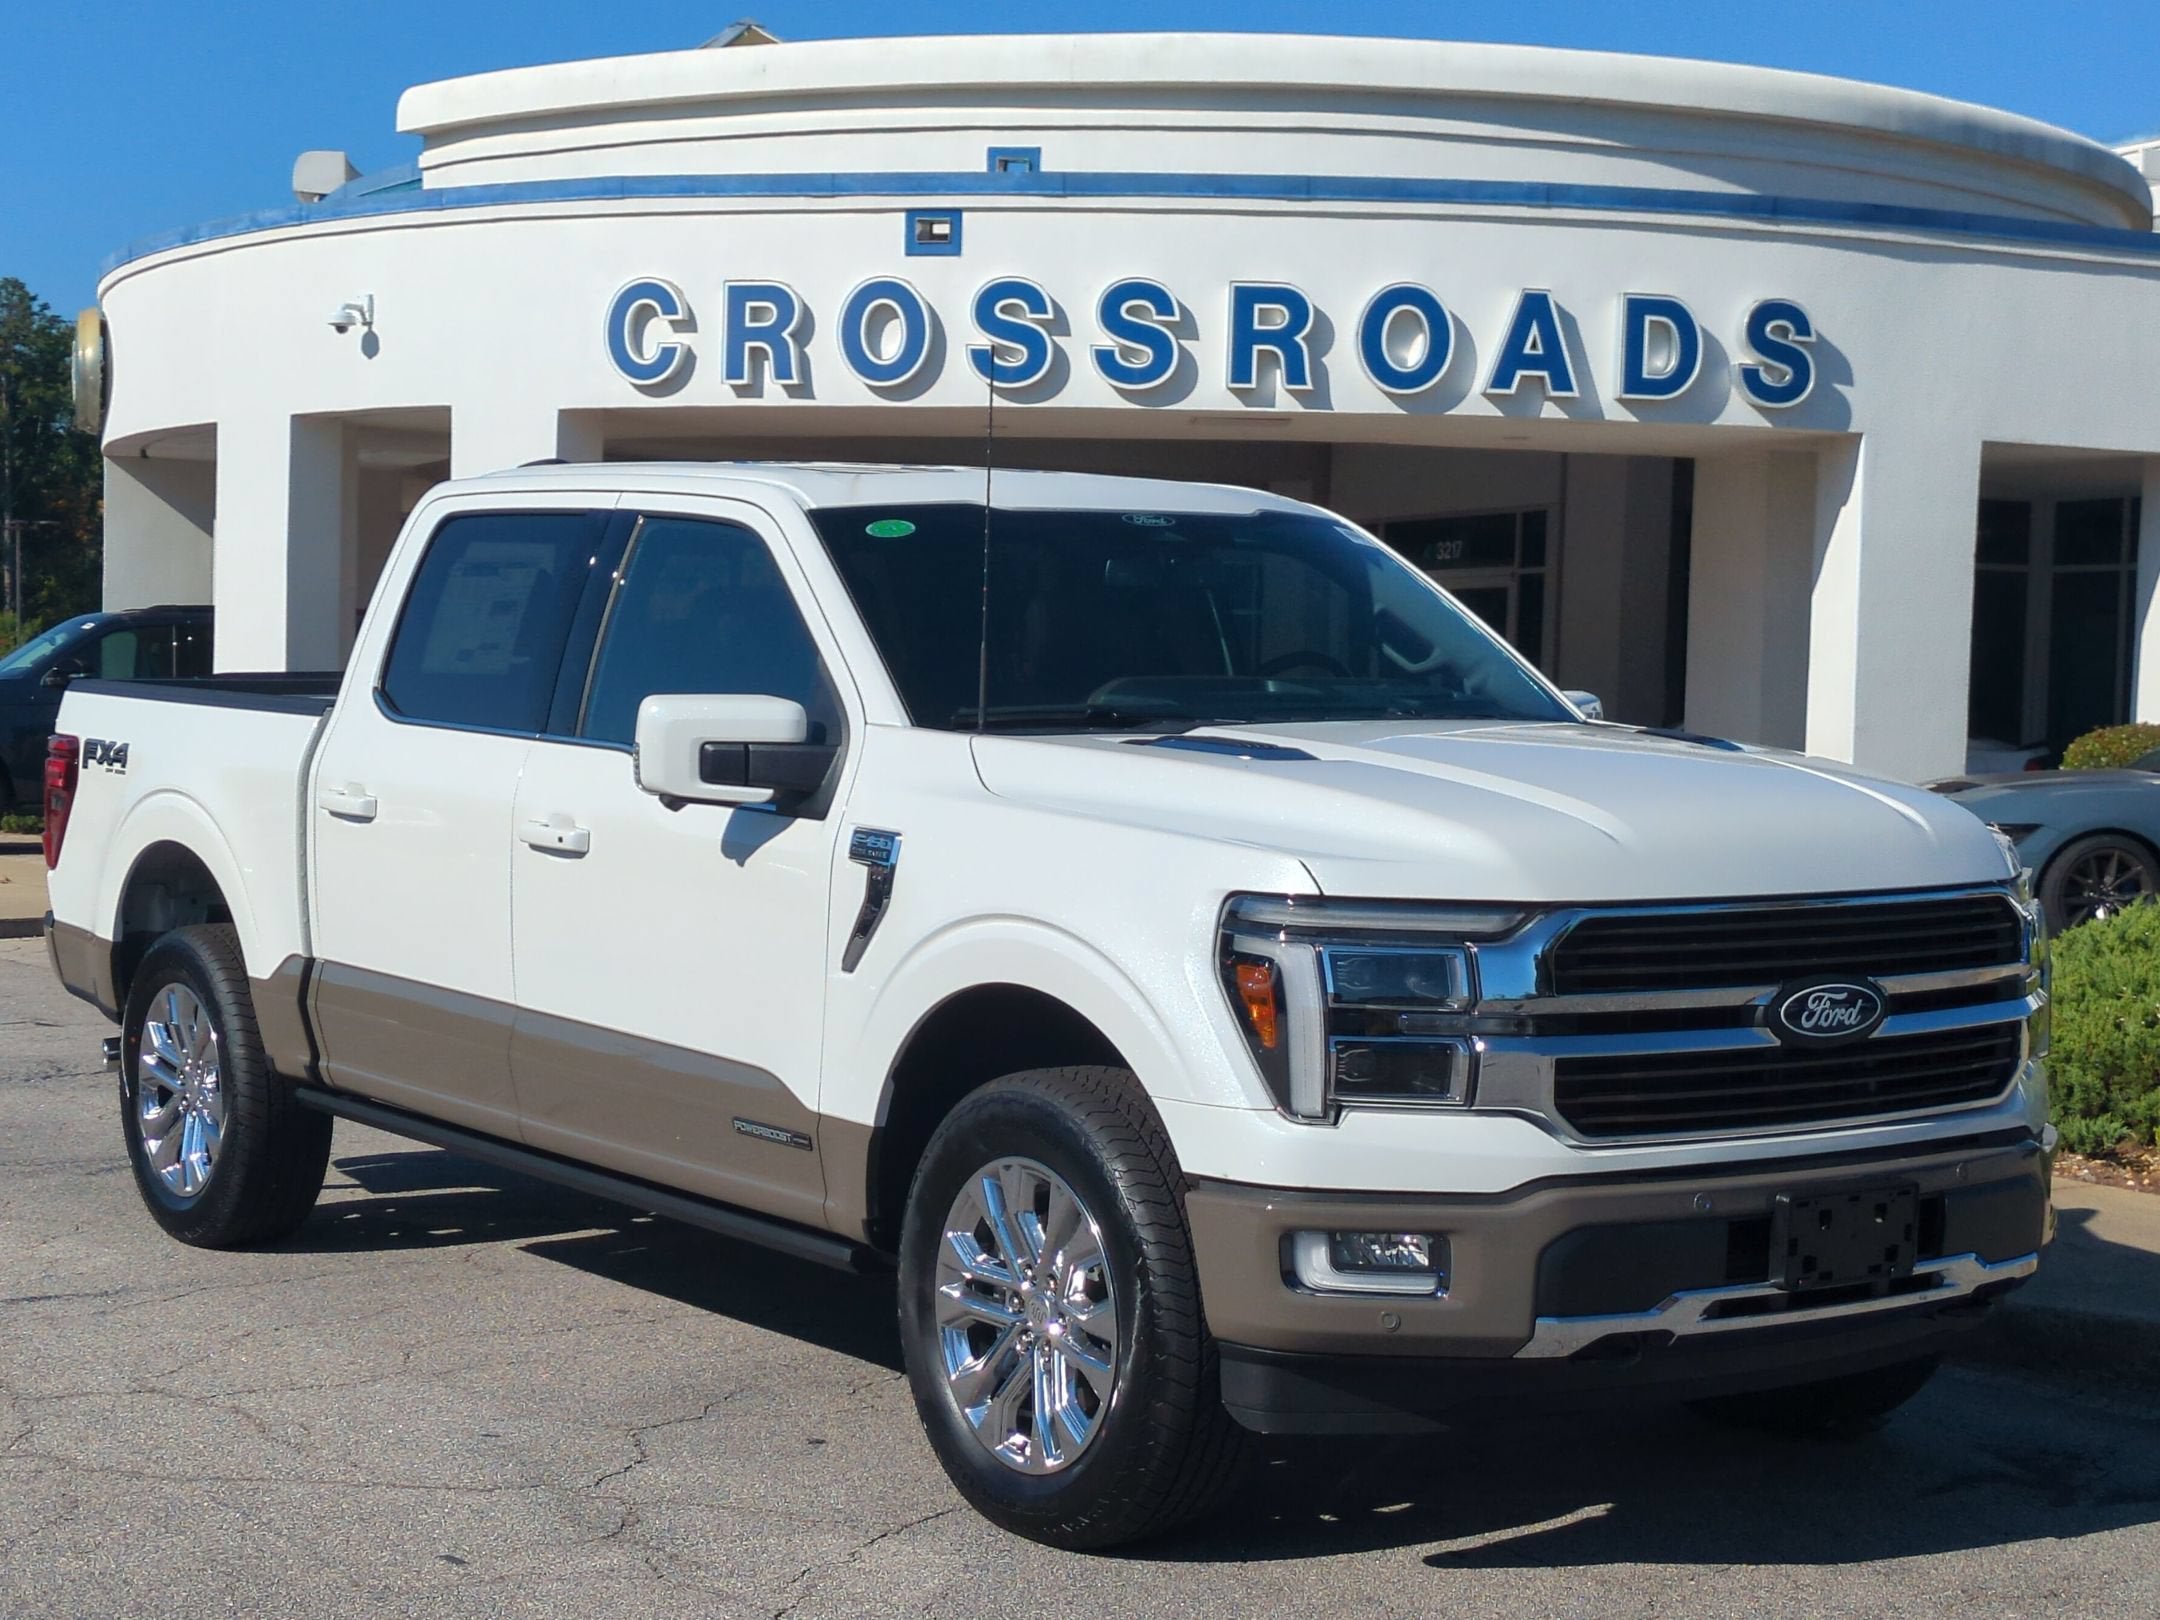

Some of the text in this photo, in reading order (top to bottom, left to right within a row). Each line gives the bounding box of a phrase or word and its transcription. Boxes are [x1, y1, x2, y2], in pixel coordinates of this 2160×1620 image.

[603, 275, 1817, 408] CROSSROADS
[1436, 540, 1463, 560] 3217
[82, 738, 130, 769] FX4
[1801, 992, 1863, 1028] Ford
